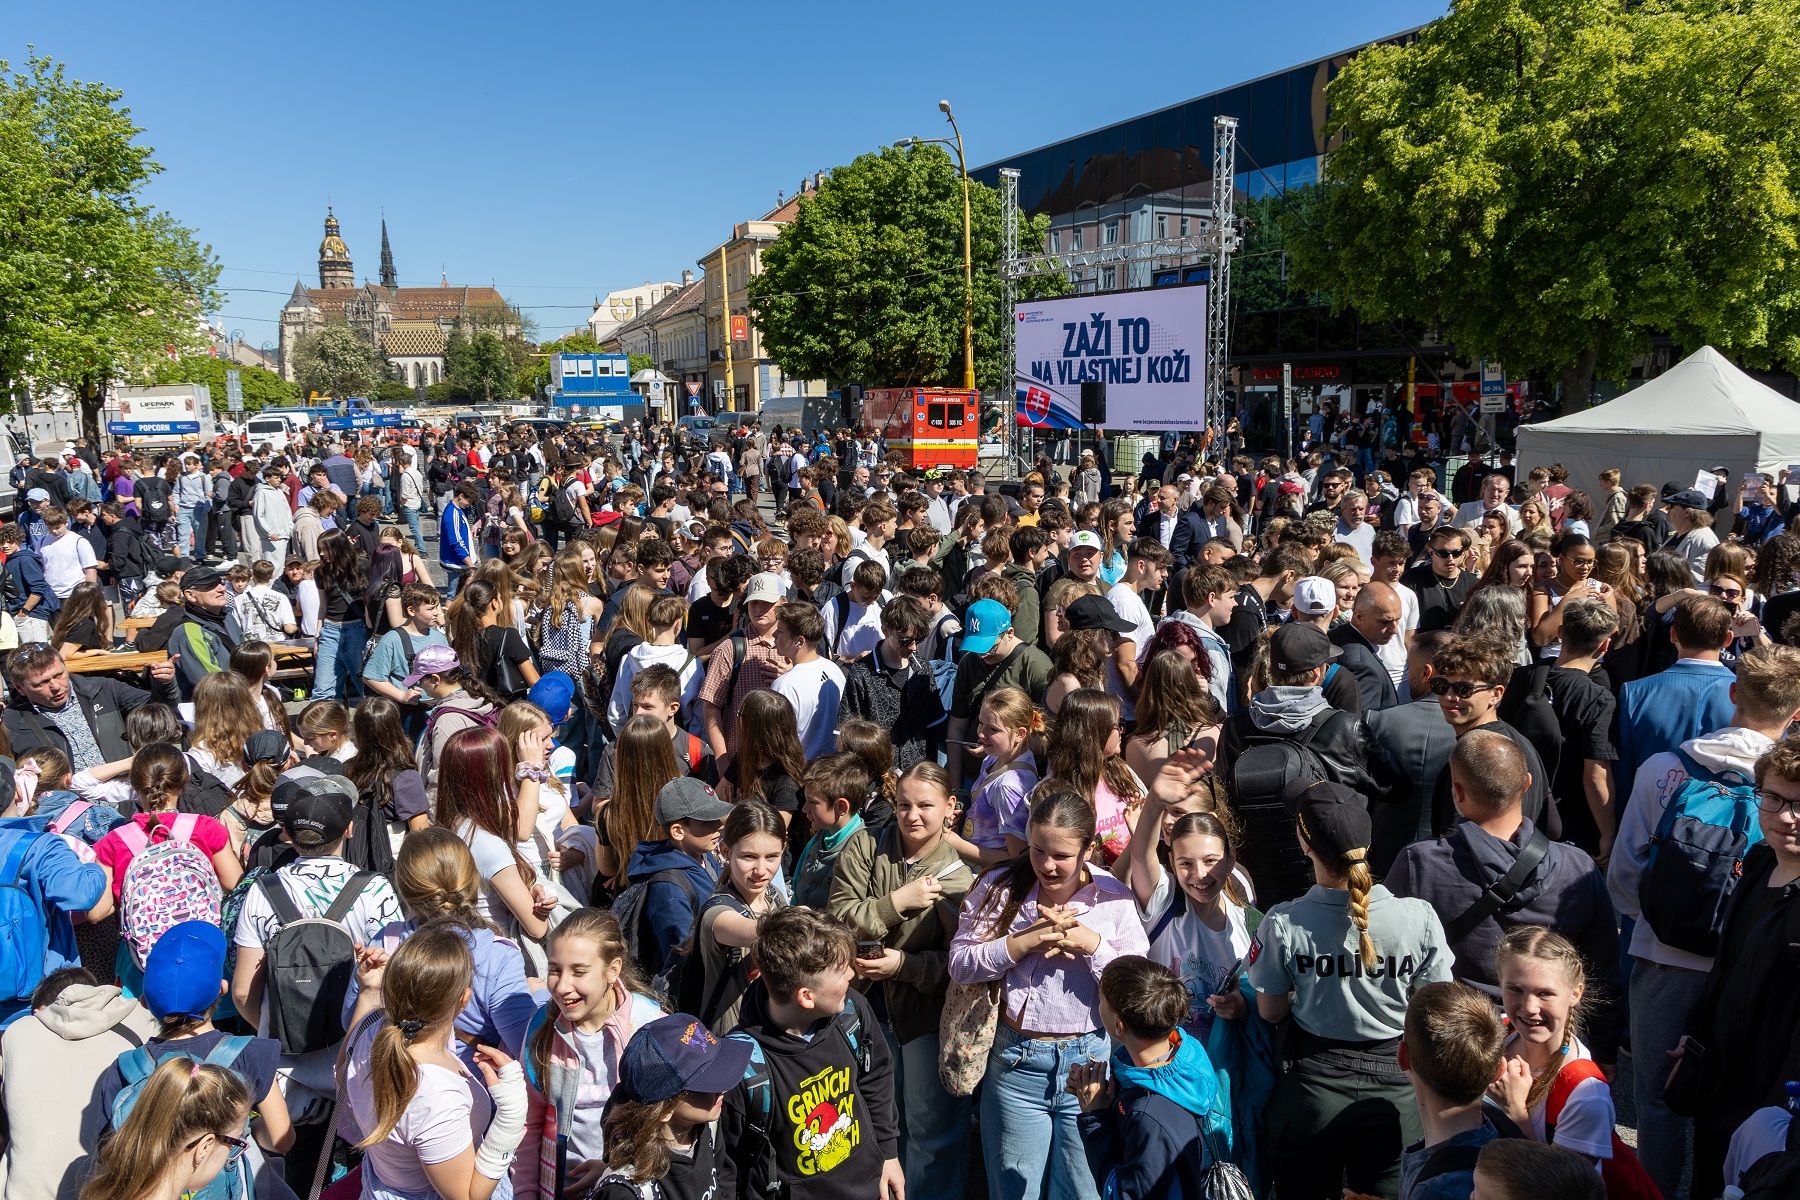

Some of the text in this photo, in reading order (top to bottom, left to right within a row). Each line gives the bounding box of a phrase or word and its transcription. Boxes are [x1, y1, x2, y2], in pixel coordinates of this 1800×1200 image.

[1063, 312, 1150, 358] ZAŽI TO
[1032, 349, 1190, 385] NA VLASTNEJ KOŽI
[1254, 366, 1339, 379] BANC CASINO
[1296, 950, 1413, 978] POLÍCIA
[788, 1067, 850, 1124] GRINCH
